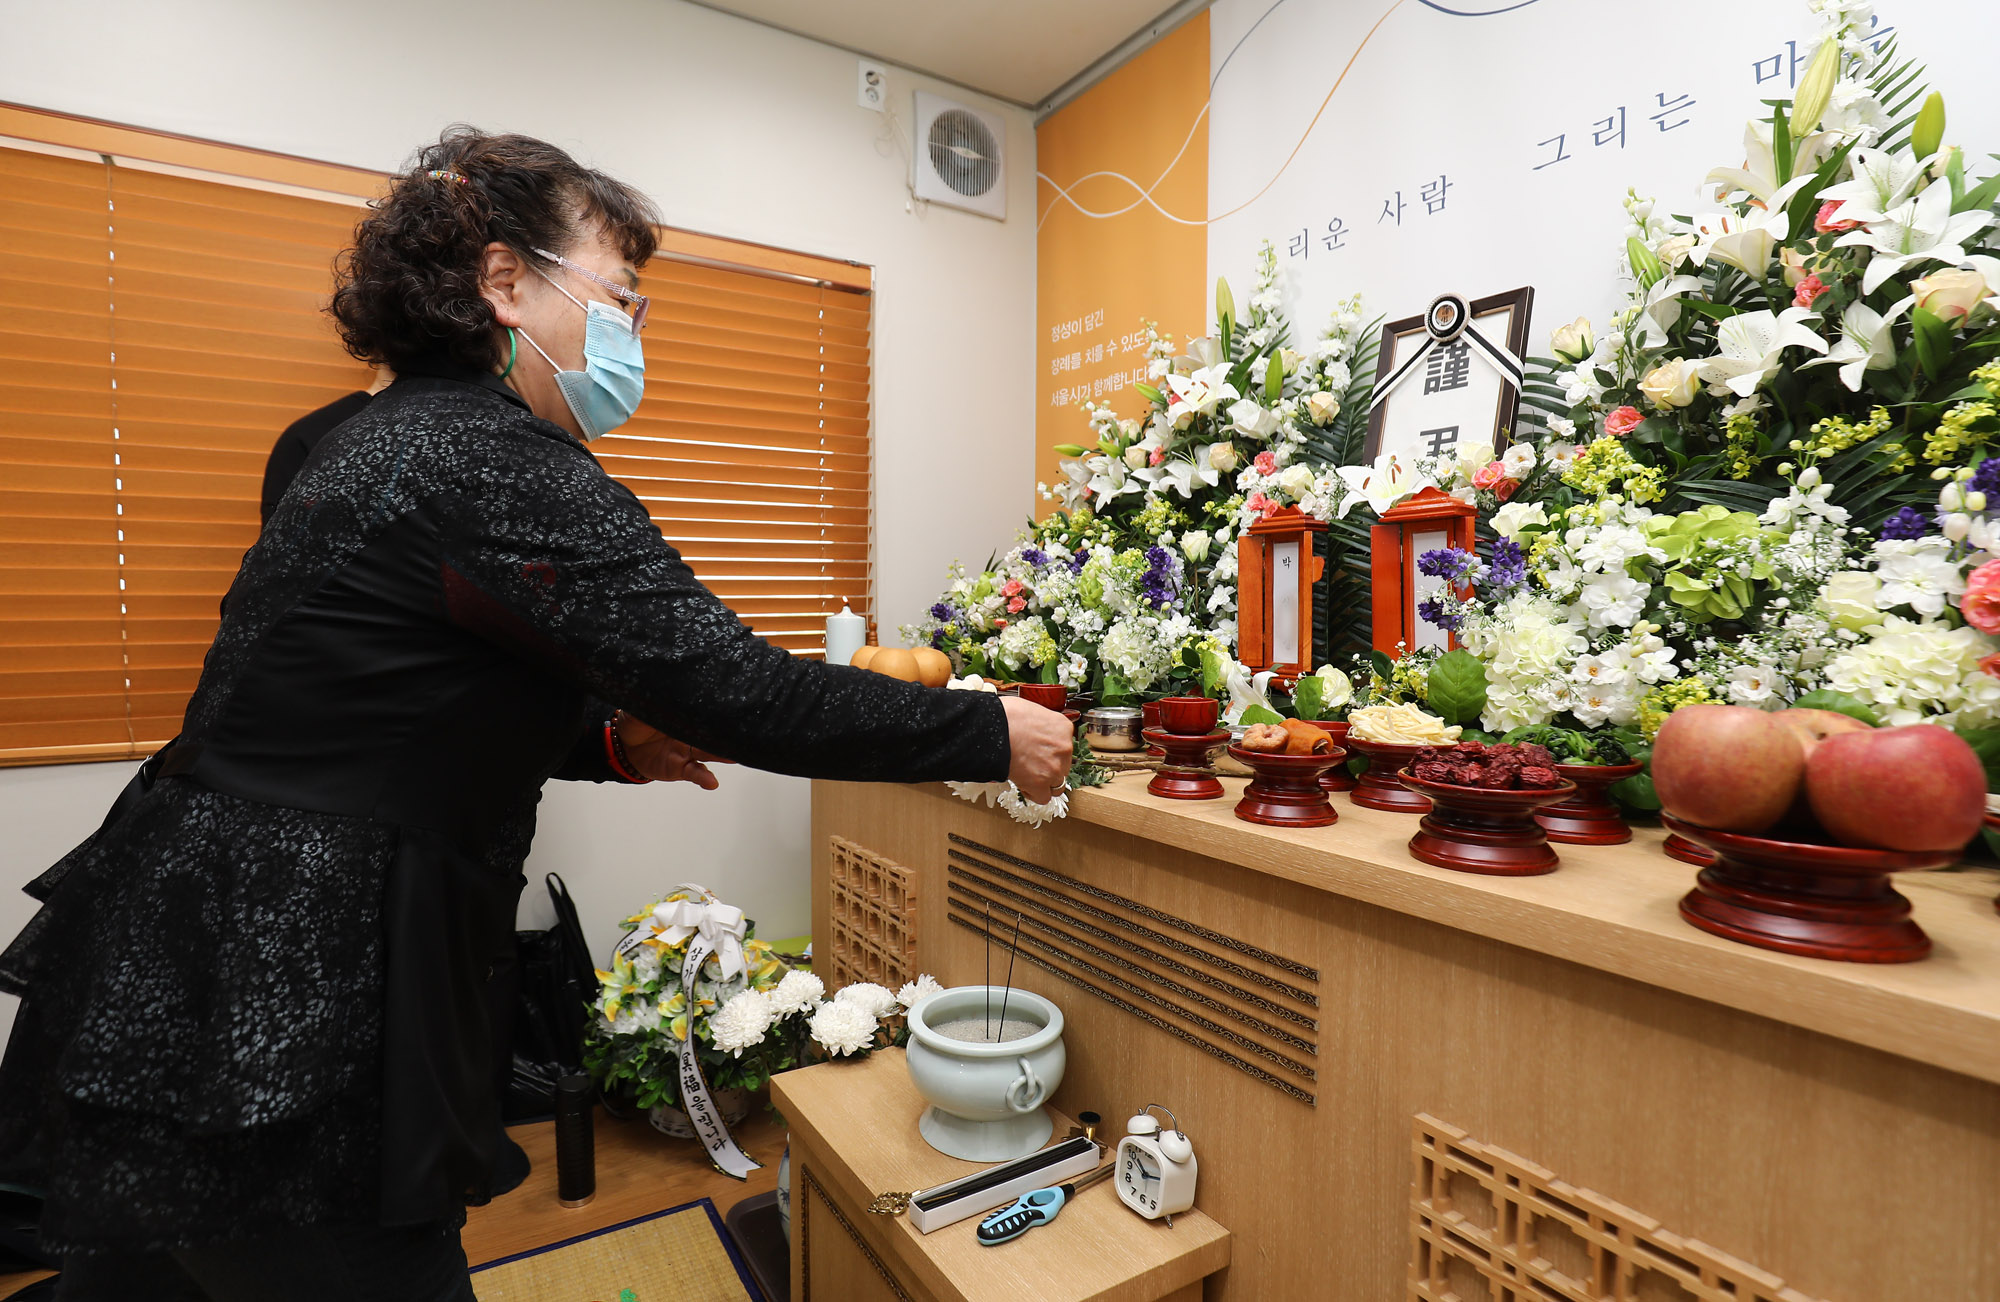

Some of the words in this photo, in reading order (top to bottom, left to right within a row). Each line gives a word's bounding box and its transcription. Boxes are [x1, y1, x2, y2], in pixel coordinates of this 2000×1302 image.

[1284, 217, 1350, 261] 리운
[1377, 174, 1454, 227] 사람
[1532, 92, 1697, 171] 그리는
[1051, 317, 1082, 343] 정성이
[1085, 308, 1104, 332] 담긴
[1051, 352, 1082, 376] 장례를
[1085, 343, 1104, 364] 치를
[1106, 339, 1118, 357] 수
[1121, 327, 1150, 353] 있도
[1051, 382, 1092, 407] 서울시가
[1094, 365, 1149, 397] 함께합니다
[1282, 556, 1292, 569] 박
[1127, 1160, 1133, 1170] 9
[1125, 1172, 1132, 1183] 8
[1131, 1186, 1137, 1196] 7
[1139, 1194, 1146, 1204] 6
[1150, 1200, 1157, 1210] 5
